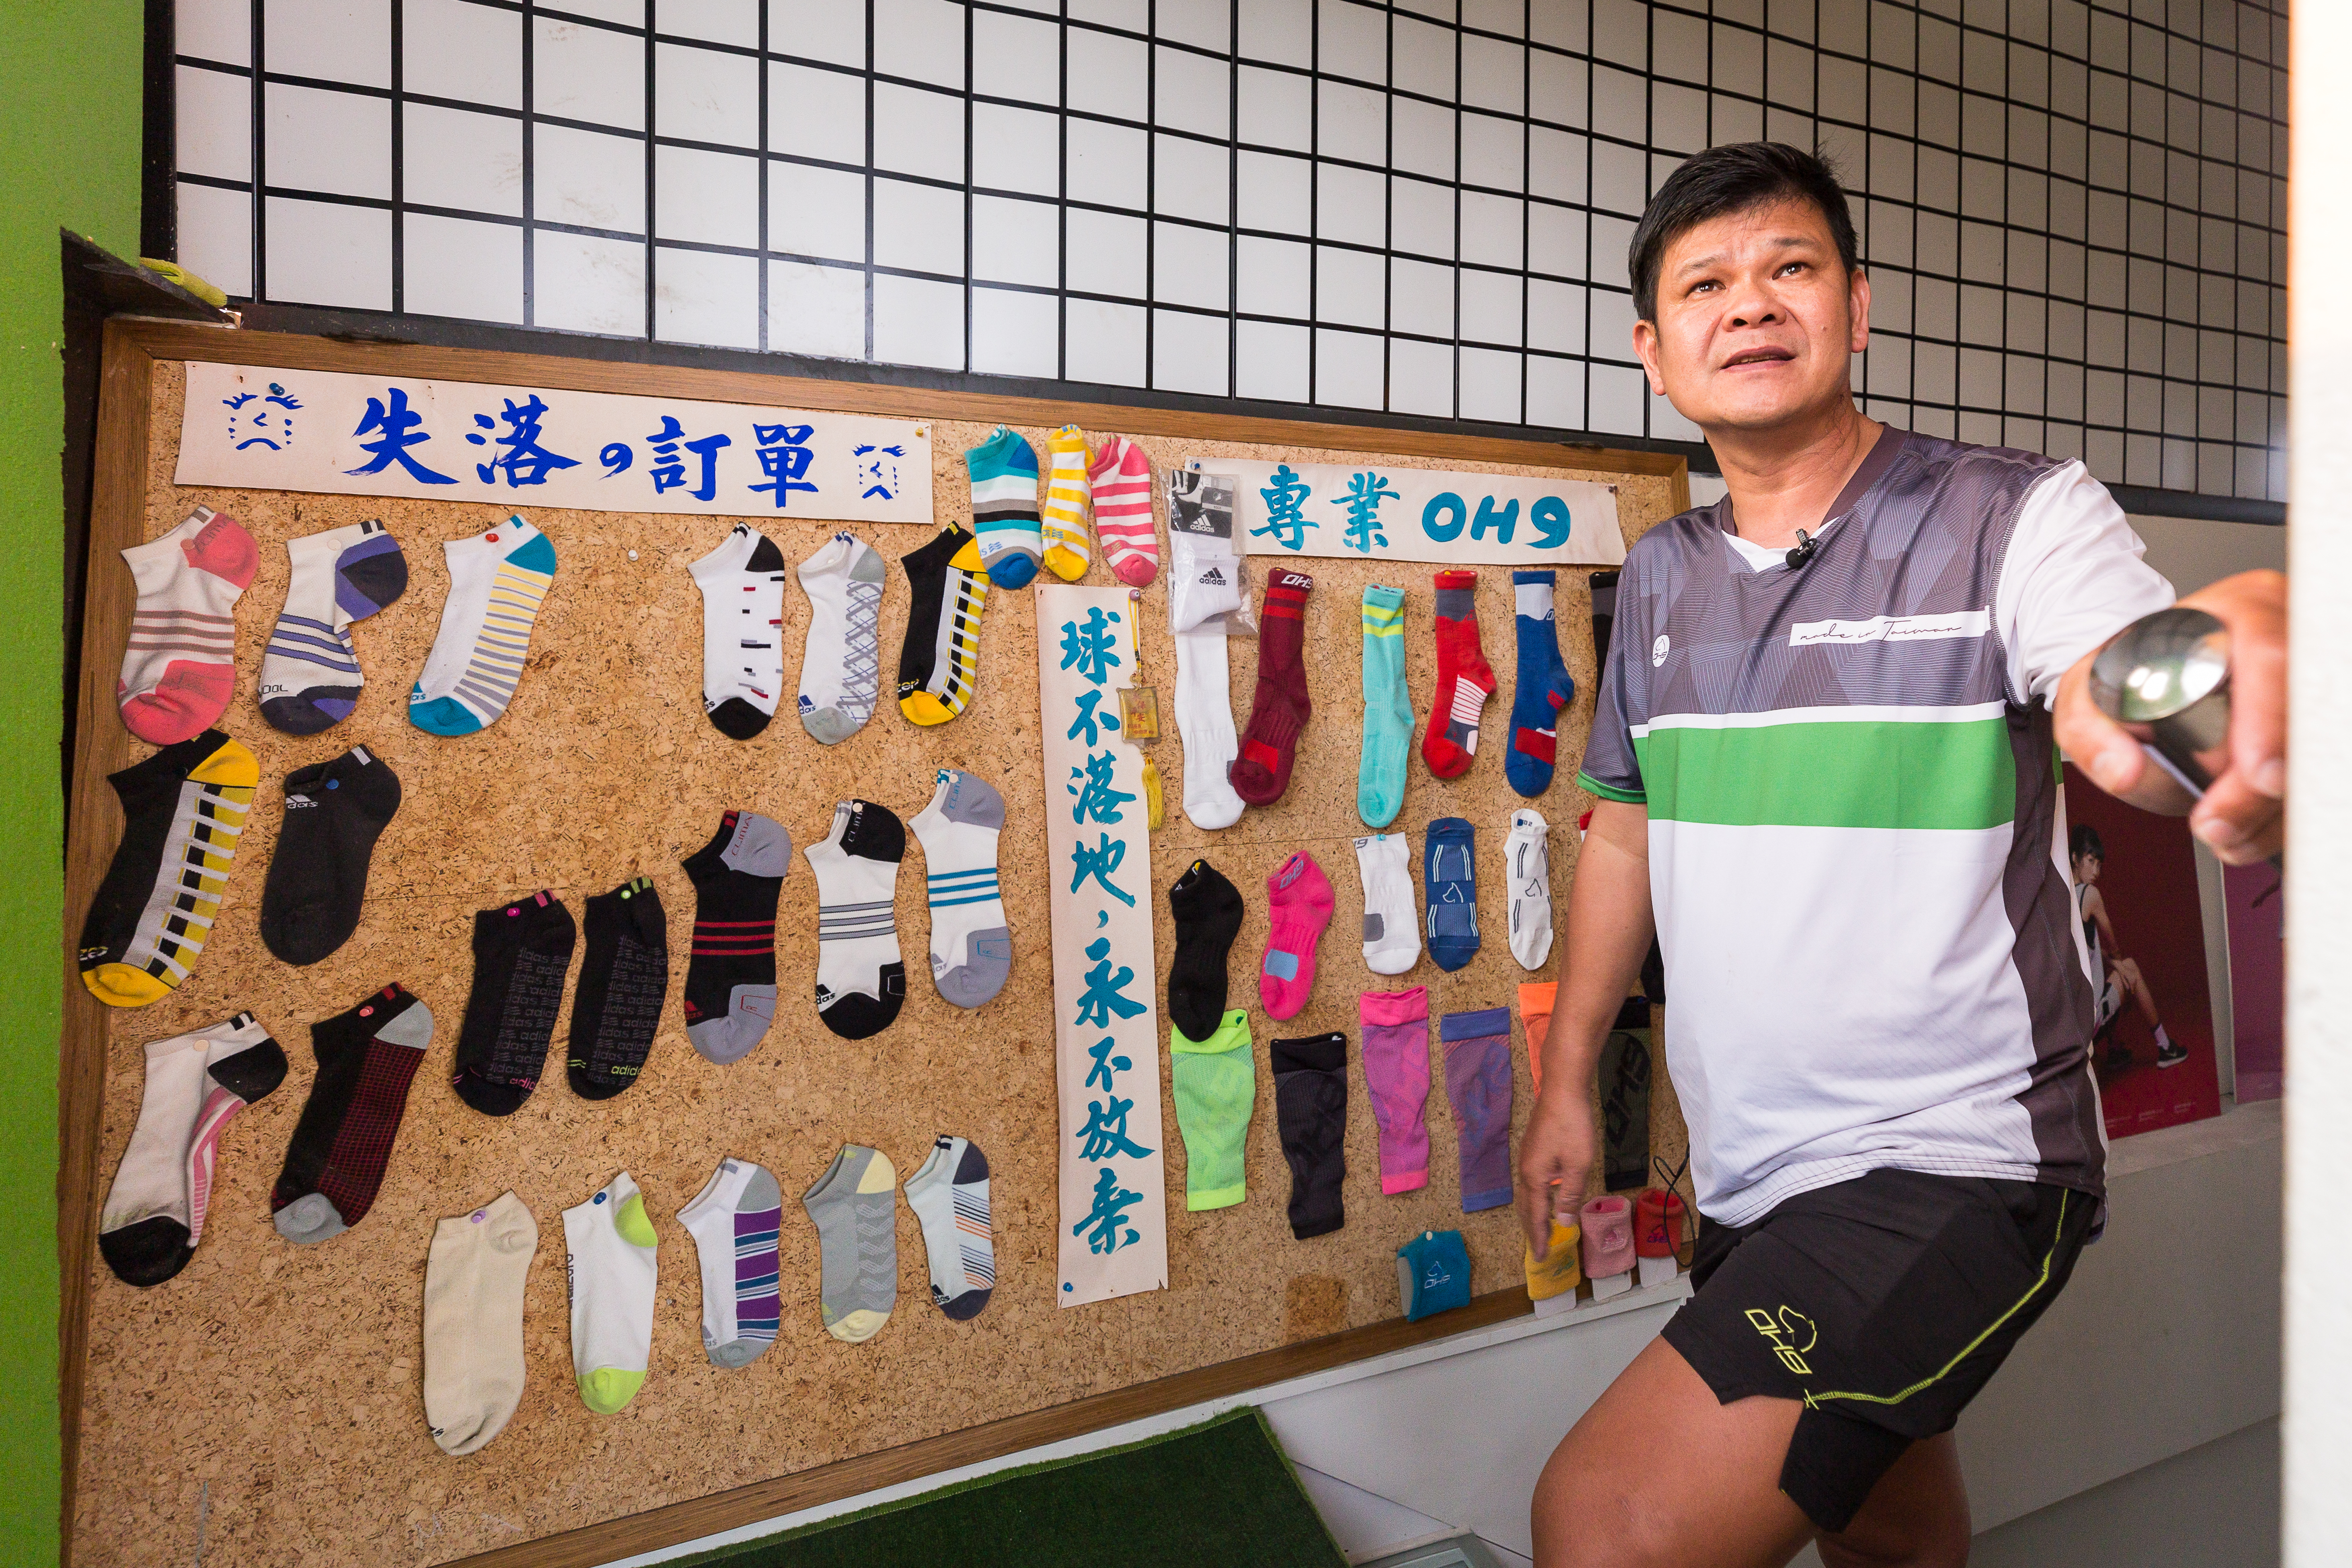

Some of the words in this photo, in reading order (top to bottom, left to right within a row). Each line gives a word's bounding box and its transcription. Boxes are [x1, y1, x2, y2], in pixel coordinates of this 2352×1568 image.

[342, 387, 818, 508] 失落の訂單
[1250, 465, 1399, 552] 專業
[1422, 493, 1570, 548] OH9
[1190, 524, 1214, 533] adidas
[1199, 577, 1227, 586] adidas
[1801, 624, 1853, 640] made
[1858, 630, 1876, 639] in
[1881, 620, 1962, 642] Taiwan
